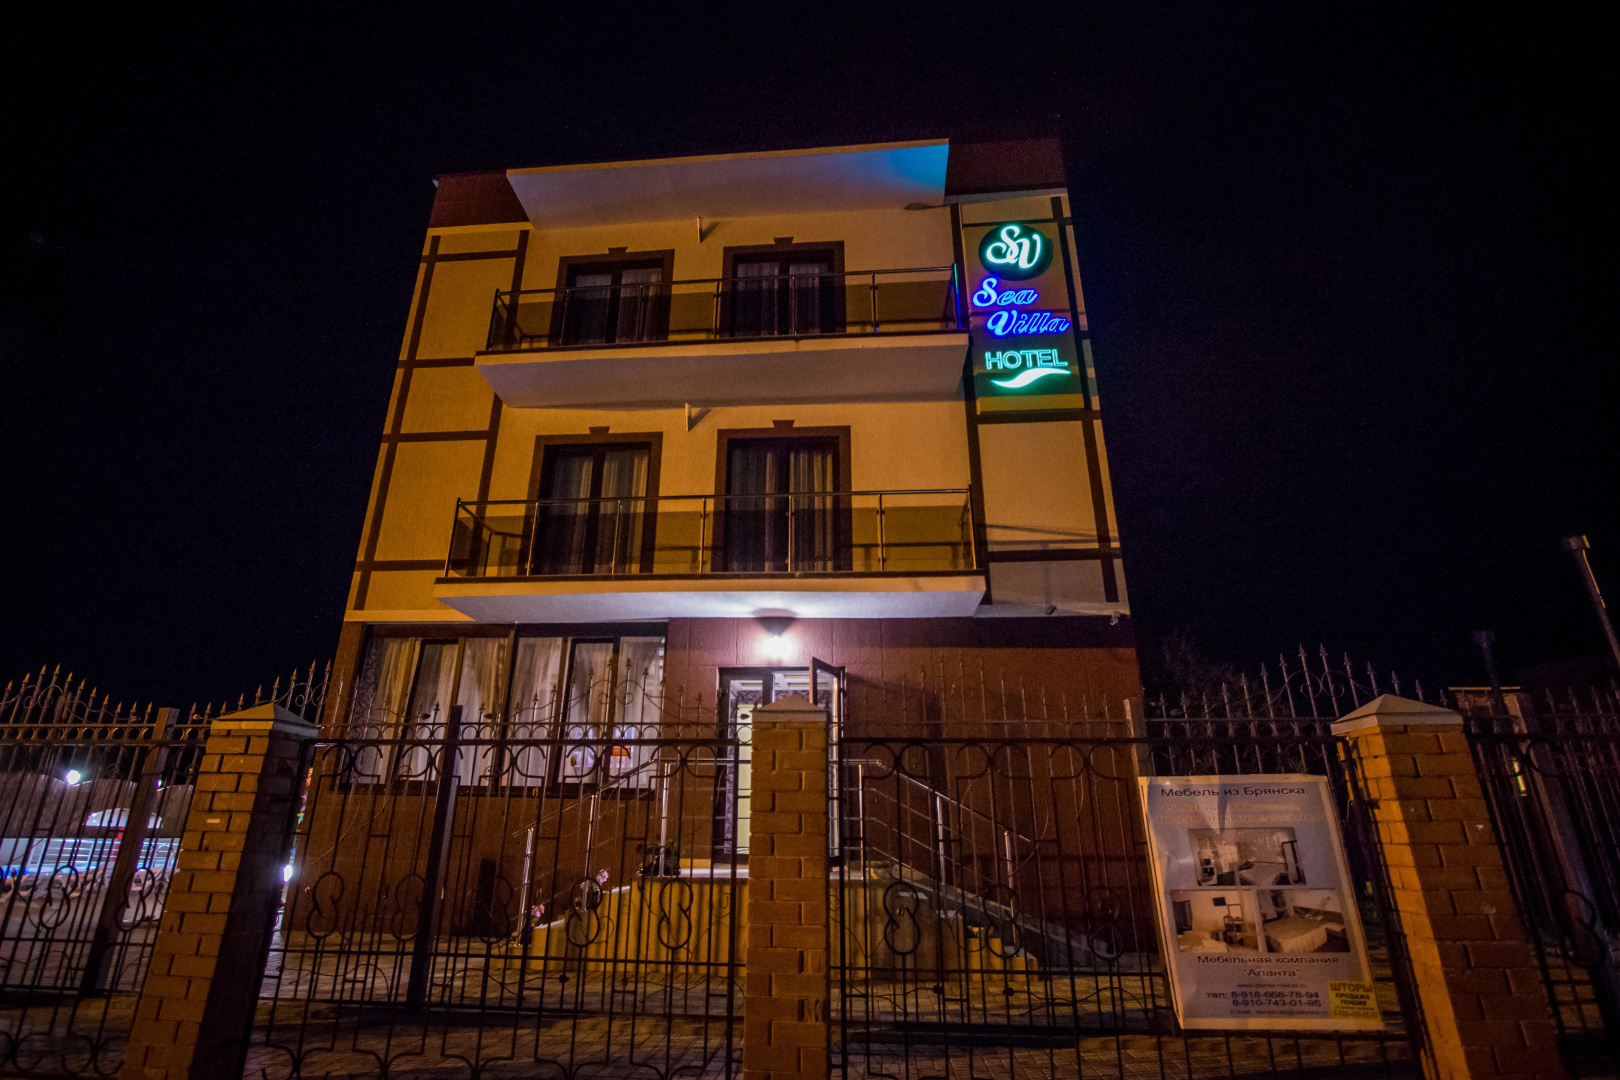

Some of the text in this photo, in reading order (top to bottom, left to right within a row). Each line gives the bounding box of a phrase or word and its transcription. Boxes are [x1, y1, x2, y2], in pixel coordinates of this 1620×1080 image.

[973, 277, 1039, 307] Sea
[986, 310, 1070, 336] Villa
[985, 350, 1068, 370] HOTEL
[1160, 786, 1306, 797] Мебель из Брянска
[1197, 955, 1272, 964] Мебельная
[1330, 982, 1374, 993] ШТОРЫ
[1335, 992, 1371, 1000] ПРОДАЖА
